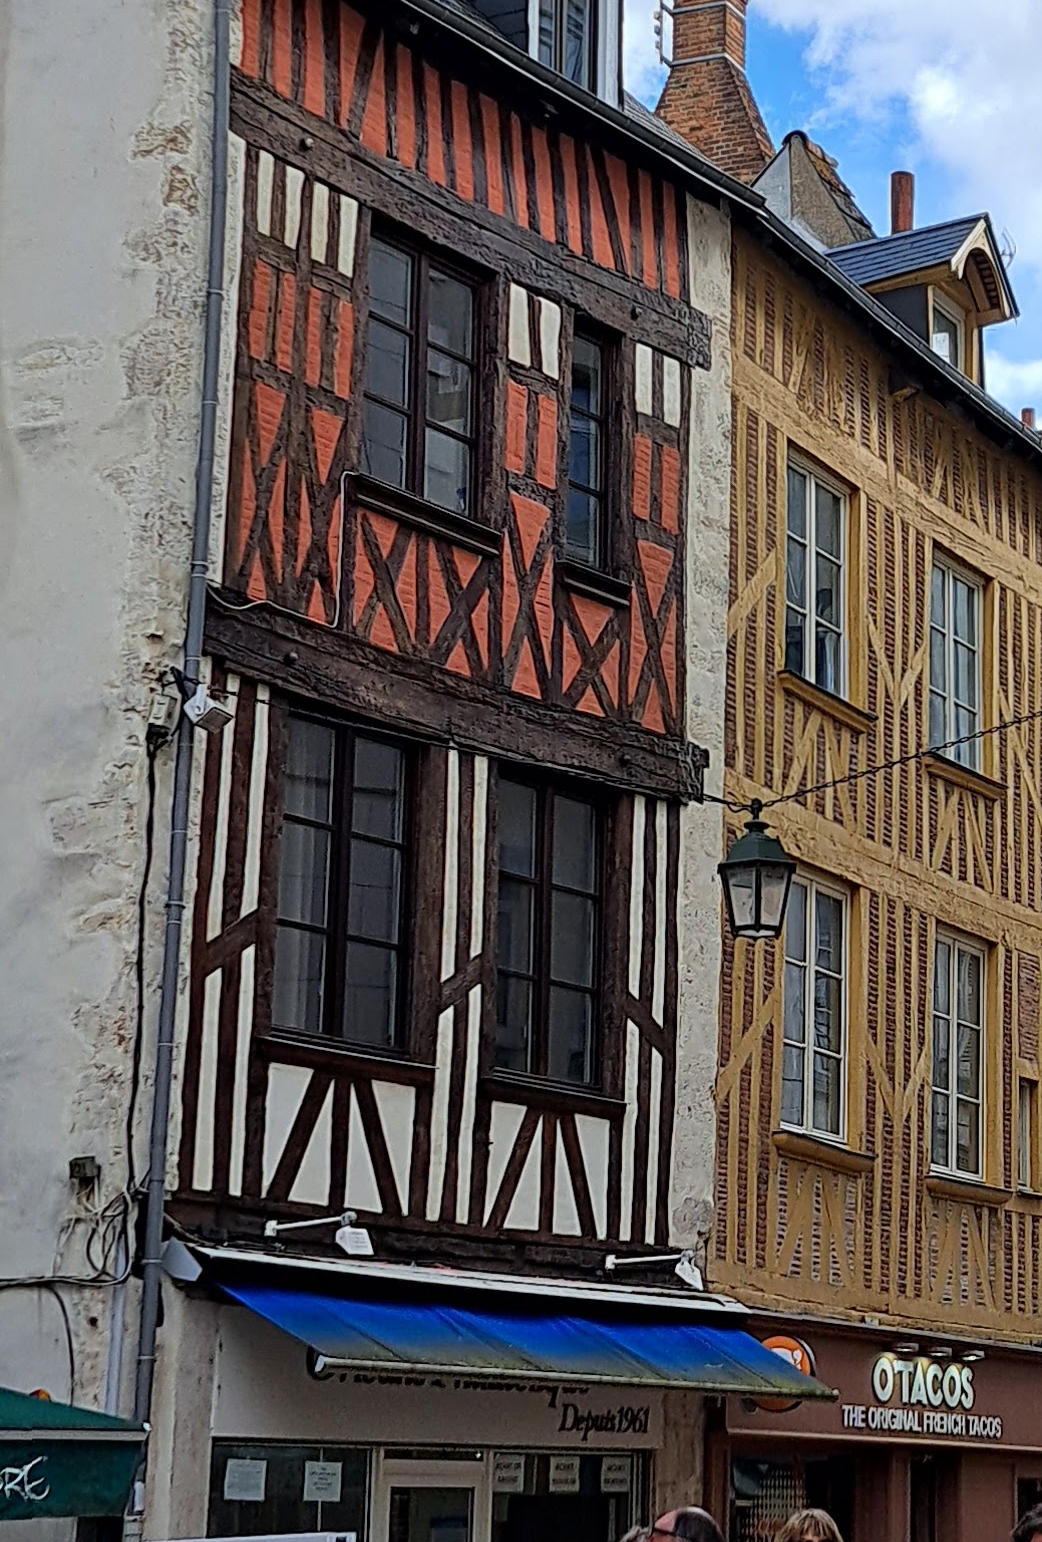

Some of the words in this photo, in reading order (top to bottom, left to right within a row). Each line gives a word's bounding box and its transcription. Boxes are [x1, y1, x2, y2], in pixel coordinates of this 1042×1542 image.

[873, 1356, 975, 1410] O'TACOS
[557, 1403, 616, 1442] Depuis
[614, 1405, 651, 1434] 1961
[842, 1404, 866, 1428] THE
[868, 1406, 923, 1433] ORIGINAL
[923, 1410, 966, 1436] FRENCH
[967, 1415, 1003, 1439] TACOS
[0, 1455, 50, 1502] RE
